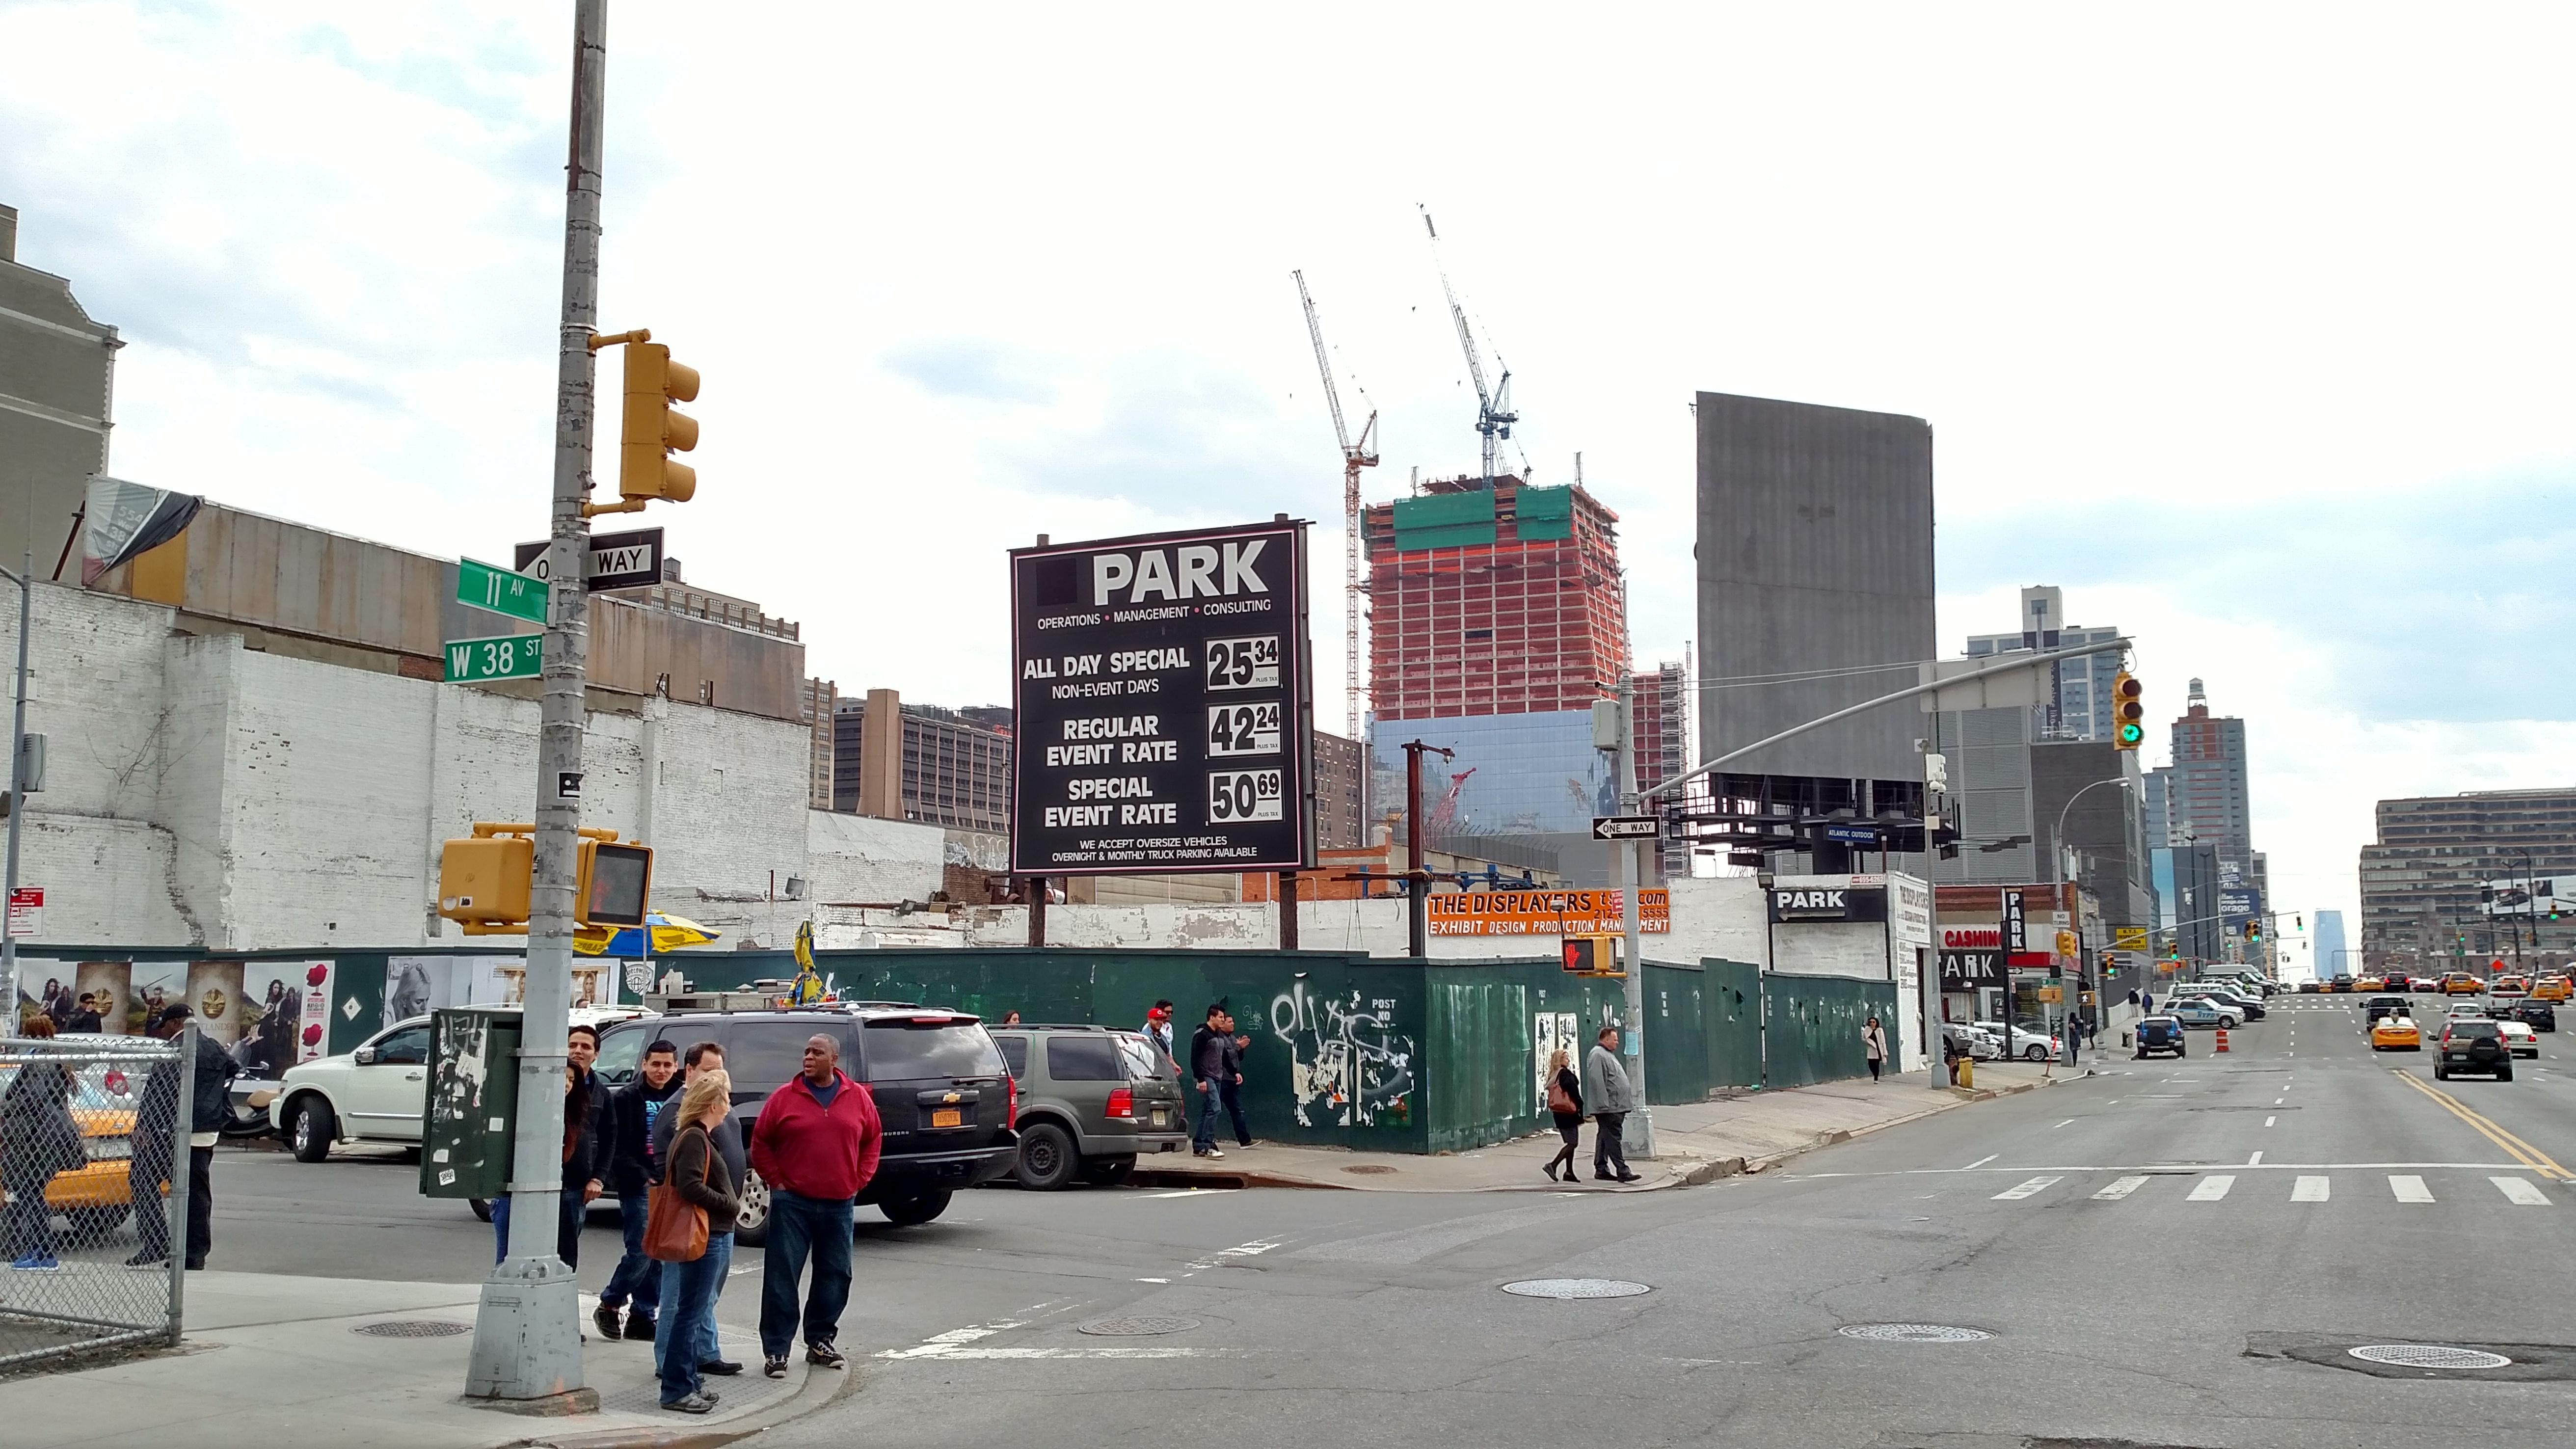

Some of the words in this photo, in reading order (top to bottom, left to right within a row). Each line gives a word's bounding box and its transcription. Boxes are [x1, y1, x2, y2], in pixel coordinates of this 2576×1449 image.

[597, 548, 642, 573] WAY
[1093, 539, 1270, 606] PARK
[486, 571, 502, 607] 11
[510, 578, 526, 597] AV
[1037, 613, 1101, 630] OPERATIONS
[1113, 606, 1190, 623] MANAGEMENT
[1203, 599, 1271, 616] CONSULTING
[452, 645, 471, 678] W
[482, 642, 514, 675] 38
[526, 639, 540, 657] ST
[1023, 658, 1057, 680] ALL
[1063, 654, 1102, 677] DAY
[1110, 647, 1190, 673] SPECIAL
[1209, 642, 1254, 686] 25
[1255, 640, 1278, 662] 34
[1052, 681, 1124, 699] NON-EVENT
[1127, 678, 1159, 694] DAYS
[1063, 715, 1159, 740] REGULAR
[1211, 707, 1256, 751] 42
[1256, 705, 1279, 728] 24
[1046, 745, 1114, 767] EVENT
[1122, 741, 1178, 763] RATE
[1068, 777, 1153, 801] SPECIAL
[1212, 774, 1257, 819] 50
[1257, 773, 1280, 796] 69
[1045, 805, 1113, 828] EVENT
[1121, 803, 1177, 825] RATE
[1603, 824, 1622, 833] ONE
[1631, 823, 1651, 832] WAY
[1052, 851, 1097, 862] OVERNIGHT
[1099, 851, 1106, 860] &
[1107, 849, 1146, 861] MONTHLY
[1147, 849, 1176, 859] TRUCK
[1176, 848, 1212, 859] PARKING
[1213, 847, 1258, 858] AVAILABLE
[1079, 839, 1096, 850] WE
[1098, 838, 1134, 849] ACCEPT
[1136, 837, 1181, 848] OVERSIZE
[1182, 836, 1228, 847] VEHICLES
[1429, 894, 1467, 915] THE
[1472, 892, 1591, 915] DISPLAYERS
[1777, 891, 1845, 909] PARK
[1429, 920, 1483, 935] EXHIBIT
[1489, 921, 1526, 934] DESIGN
[1532, 919, 1595, 933] PRODUCTION
[1593, 909, 1613, 921] 212
[1641, 908, 1669, 919] 5555
[2009, 892, 2022, 947] PARK
[1938, 955, 1995, 978] ARK
[1372, 998, 1396, 1009] POST
[1377, 1011, 1391, 1021] NO
